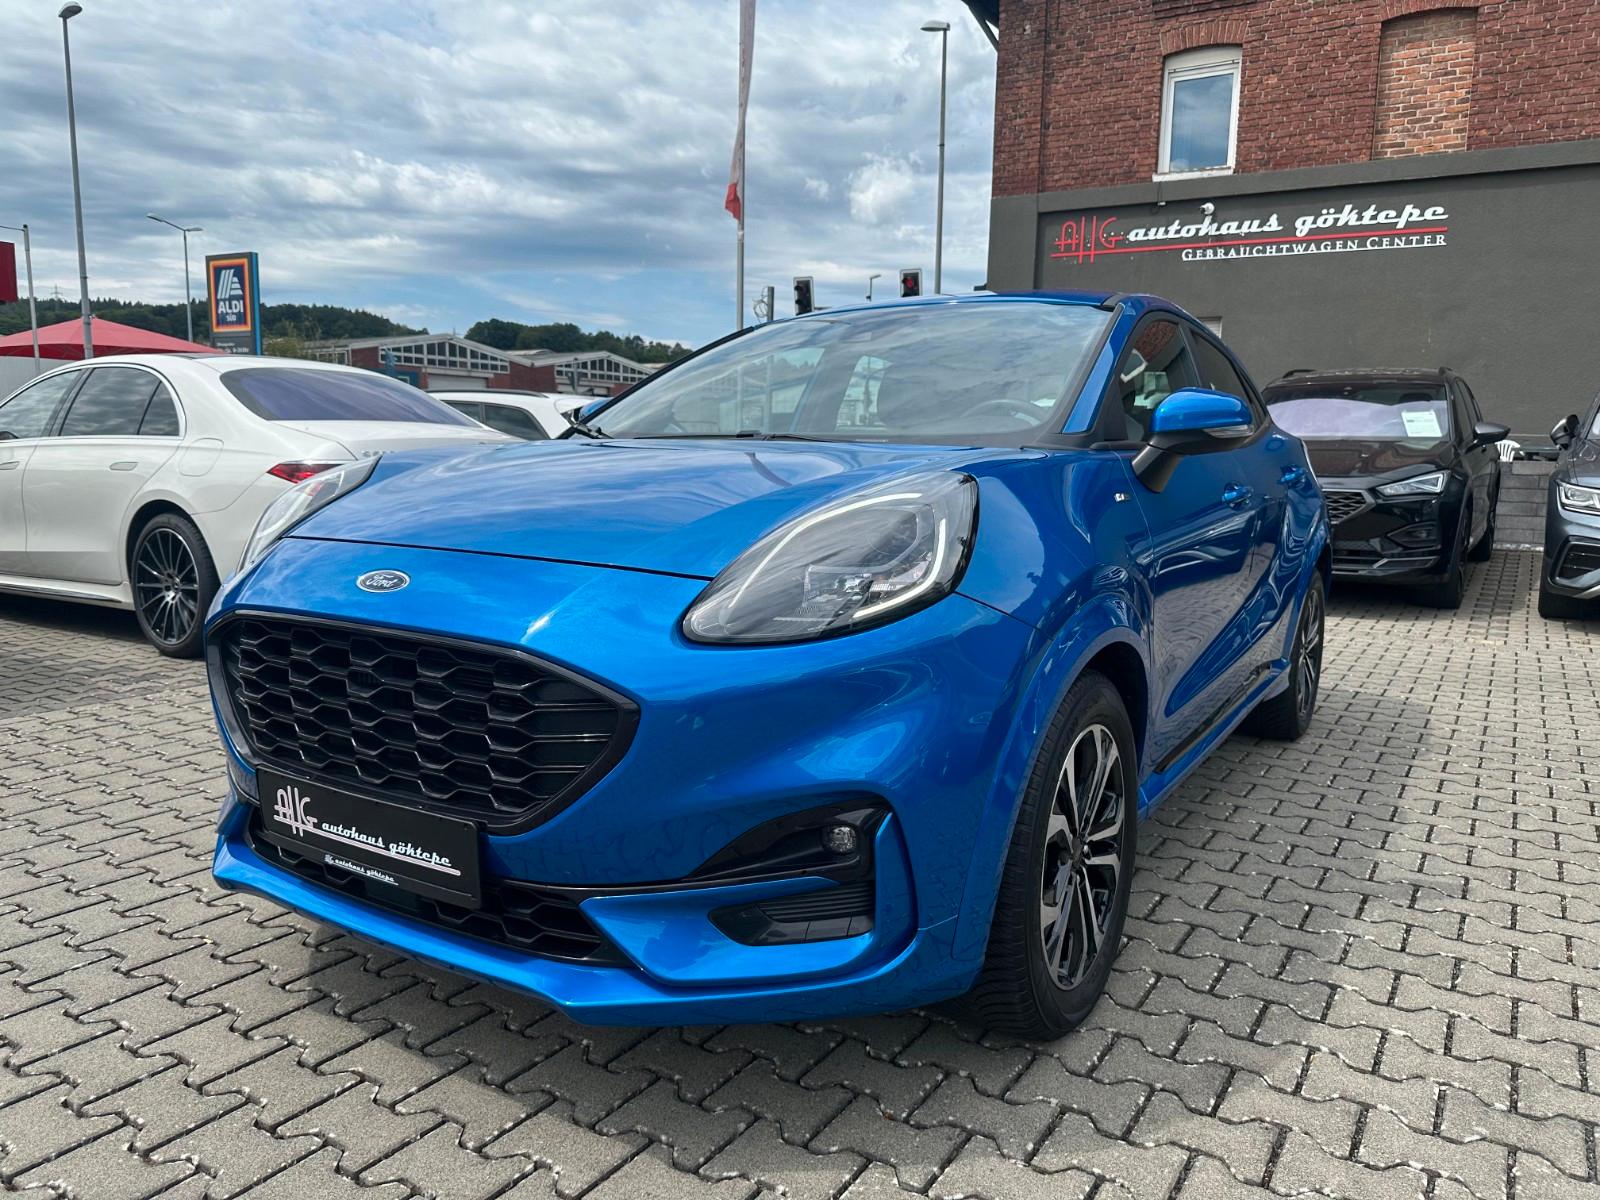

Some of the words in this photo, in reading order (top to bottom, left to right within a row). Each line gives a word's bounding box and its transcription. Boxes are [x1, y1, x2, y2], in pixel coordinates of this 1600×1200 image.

[1127, 213, 1283, 243] autohaus
[1295, 203, 1449, 238] göktepe
[1181, 240, 1359, 261] GEBRAUCHTWAGEN
[1366, 234, 1448, 250] CENTER
[218, 300, 244, 314] ALDI
[366, 574, 398, 588] Ford
[321, 822, 386, 848] autohaus
[388, 842, 452, 867] göktepe
[334, 857, 366, 873] autohaus
